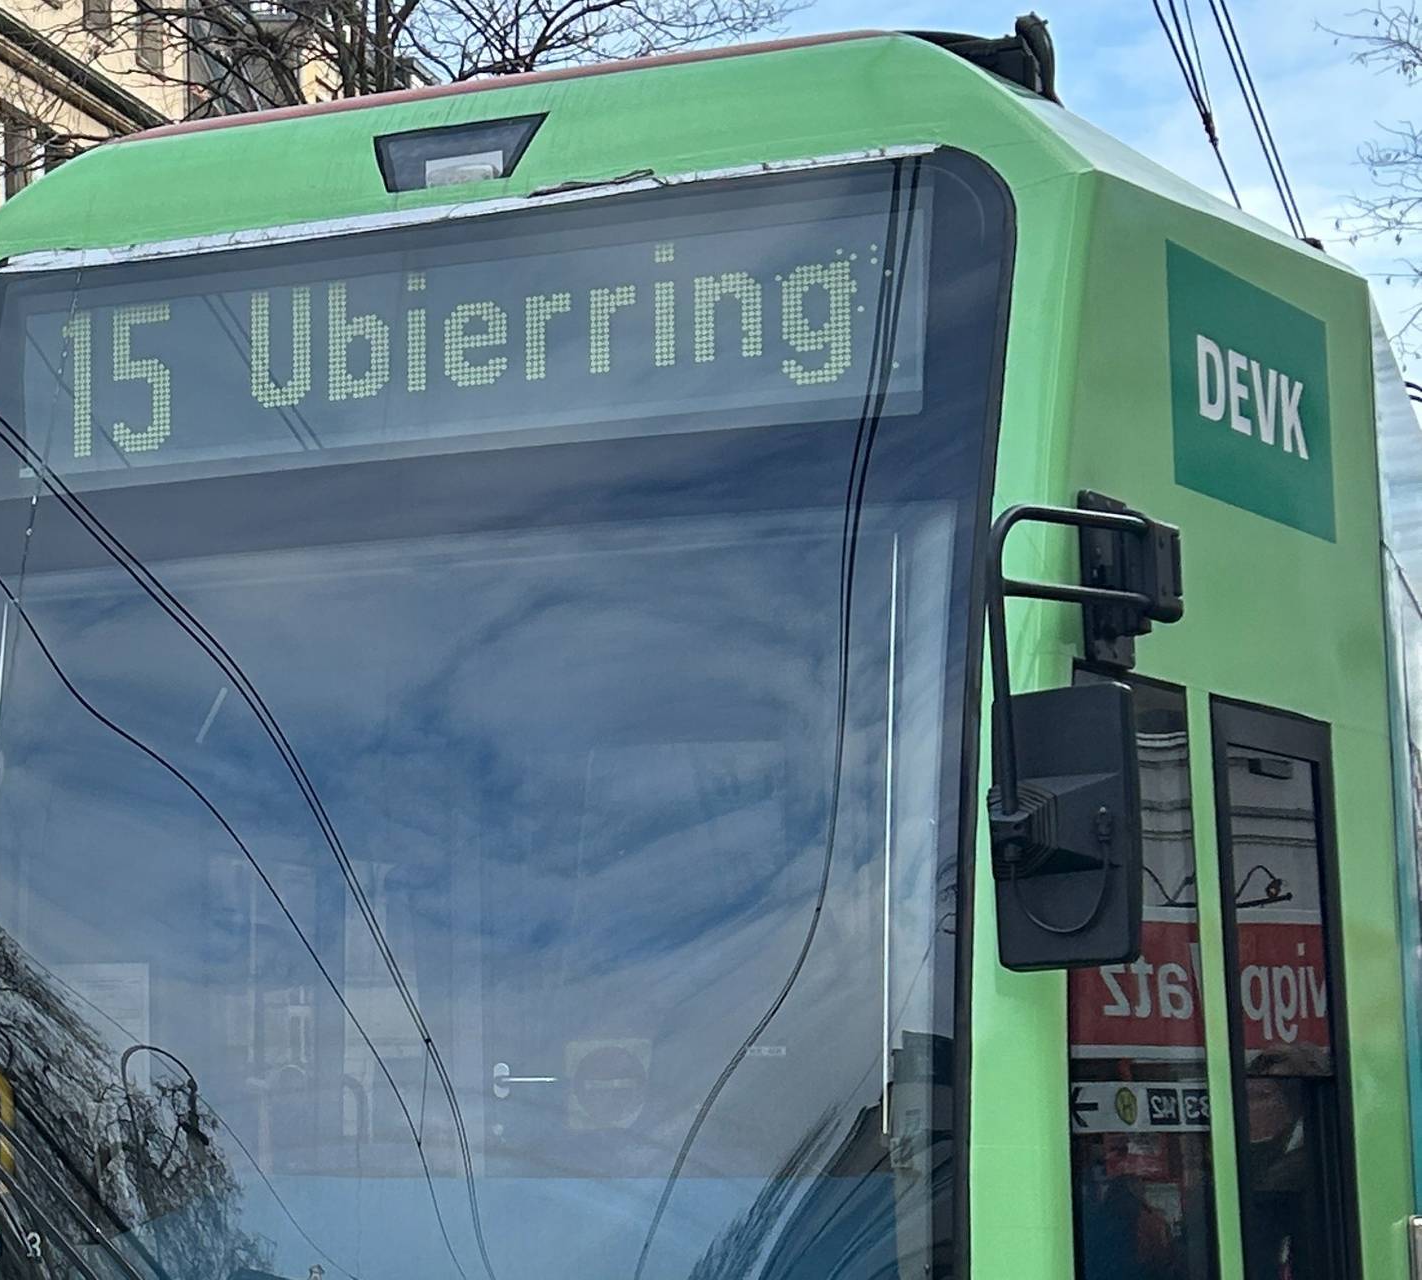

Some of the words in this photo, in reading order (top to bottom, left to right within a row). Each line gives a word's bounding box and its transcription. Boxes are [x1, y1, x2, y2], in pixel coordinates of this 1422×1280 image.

[63, 302, 172, 457] 15
[250, 242, 857, 408] Ubierring
[1197, 334, 1309, 460] DEVK
